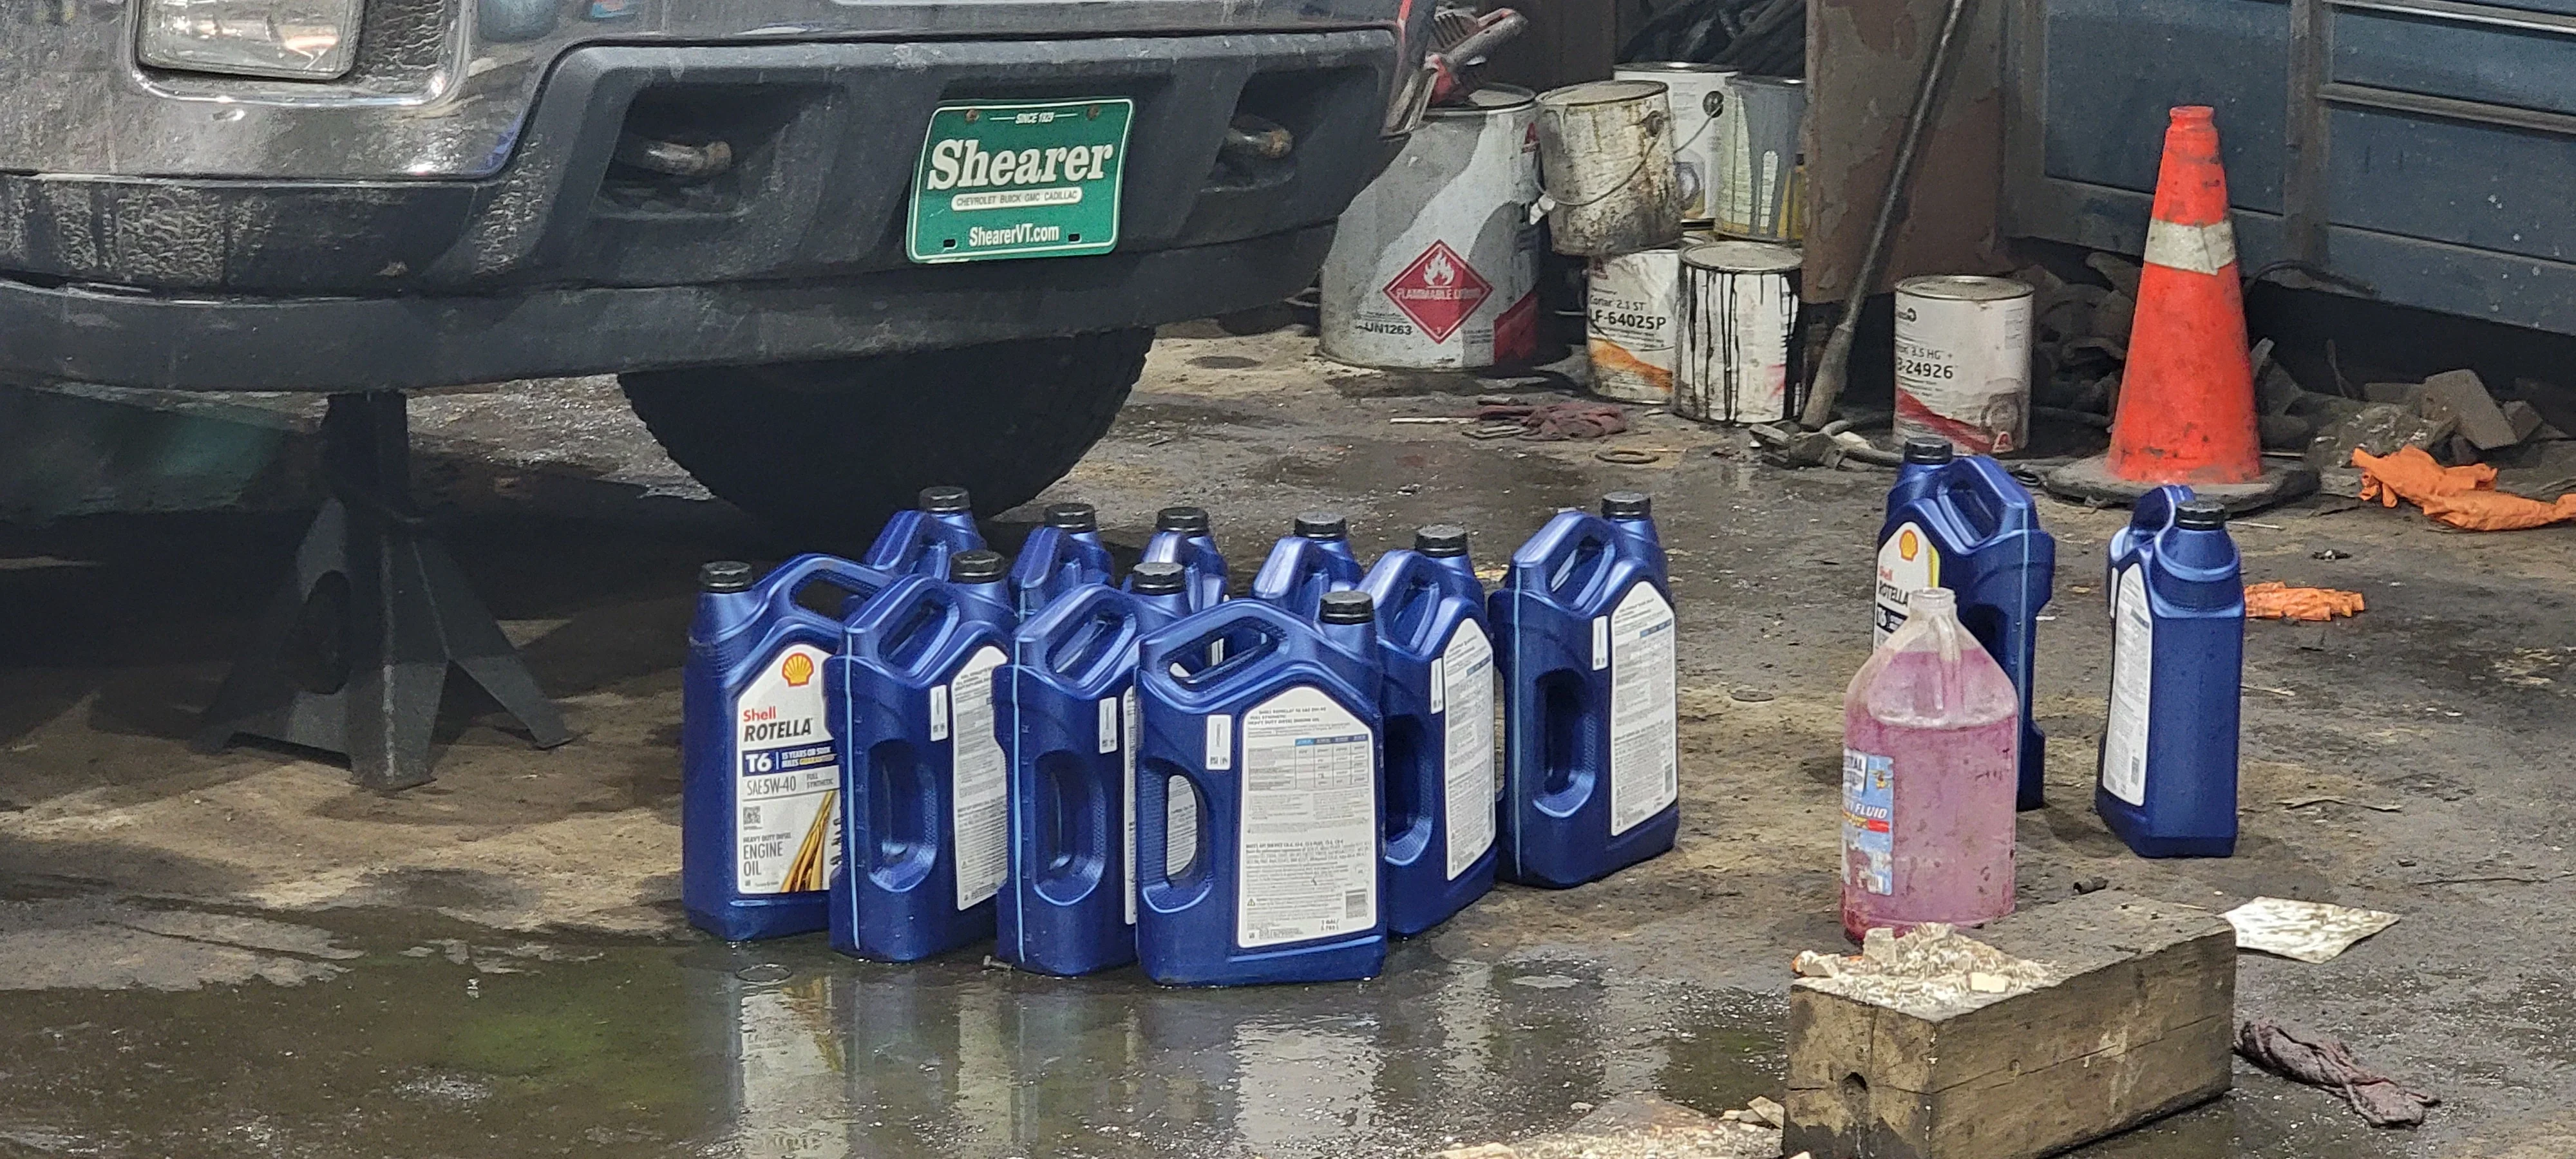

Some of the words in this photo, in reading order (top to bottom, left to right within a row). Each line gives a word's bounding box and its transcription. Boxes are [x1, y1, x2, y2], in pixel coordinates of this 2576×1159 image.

[1016, 112, 1039, 124] SINCE
[927, 138, 1113, 191] Shearer
[956, 195, 996, 207] CHEVROLET
[999, 194, 1021, 203] BUICK
[1025, 193, 1040, 202] GMC
[1044, 190, 1077, 201] CADILLAC
[969, 223, 1059, 247] ShearerVT.com
[1633, 301, 1647, 311] ST
[1365, 322, 1413, 335] UN1263
[743, 706, 777, 722] Shell
[744, 718, 812, 742] ROTELLA
[788, 749, 807, 759] YEARS
[745, 753, 772, 773] T6
[1855, 803, 1888, 820] FLUID
[743, 841, 783, 860] ENGINE
[743, 860, 761, 876] OIL
